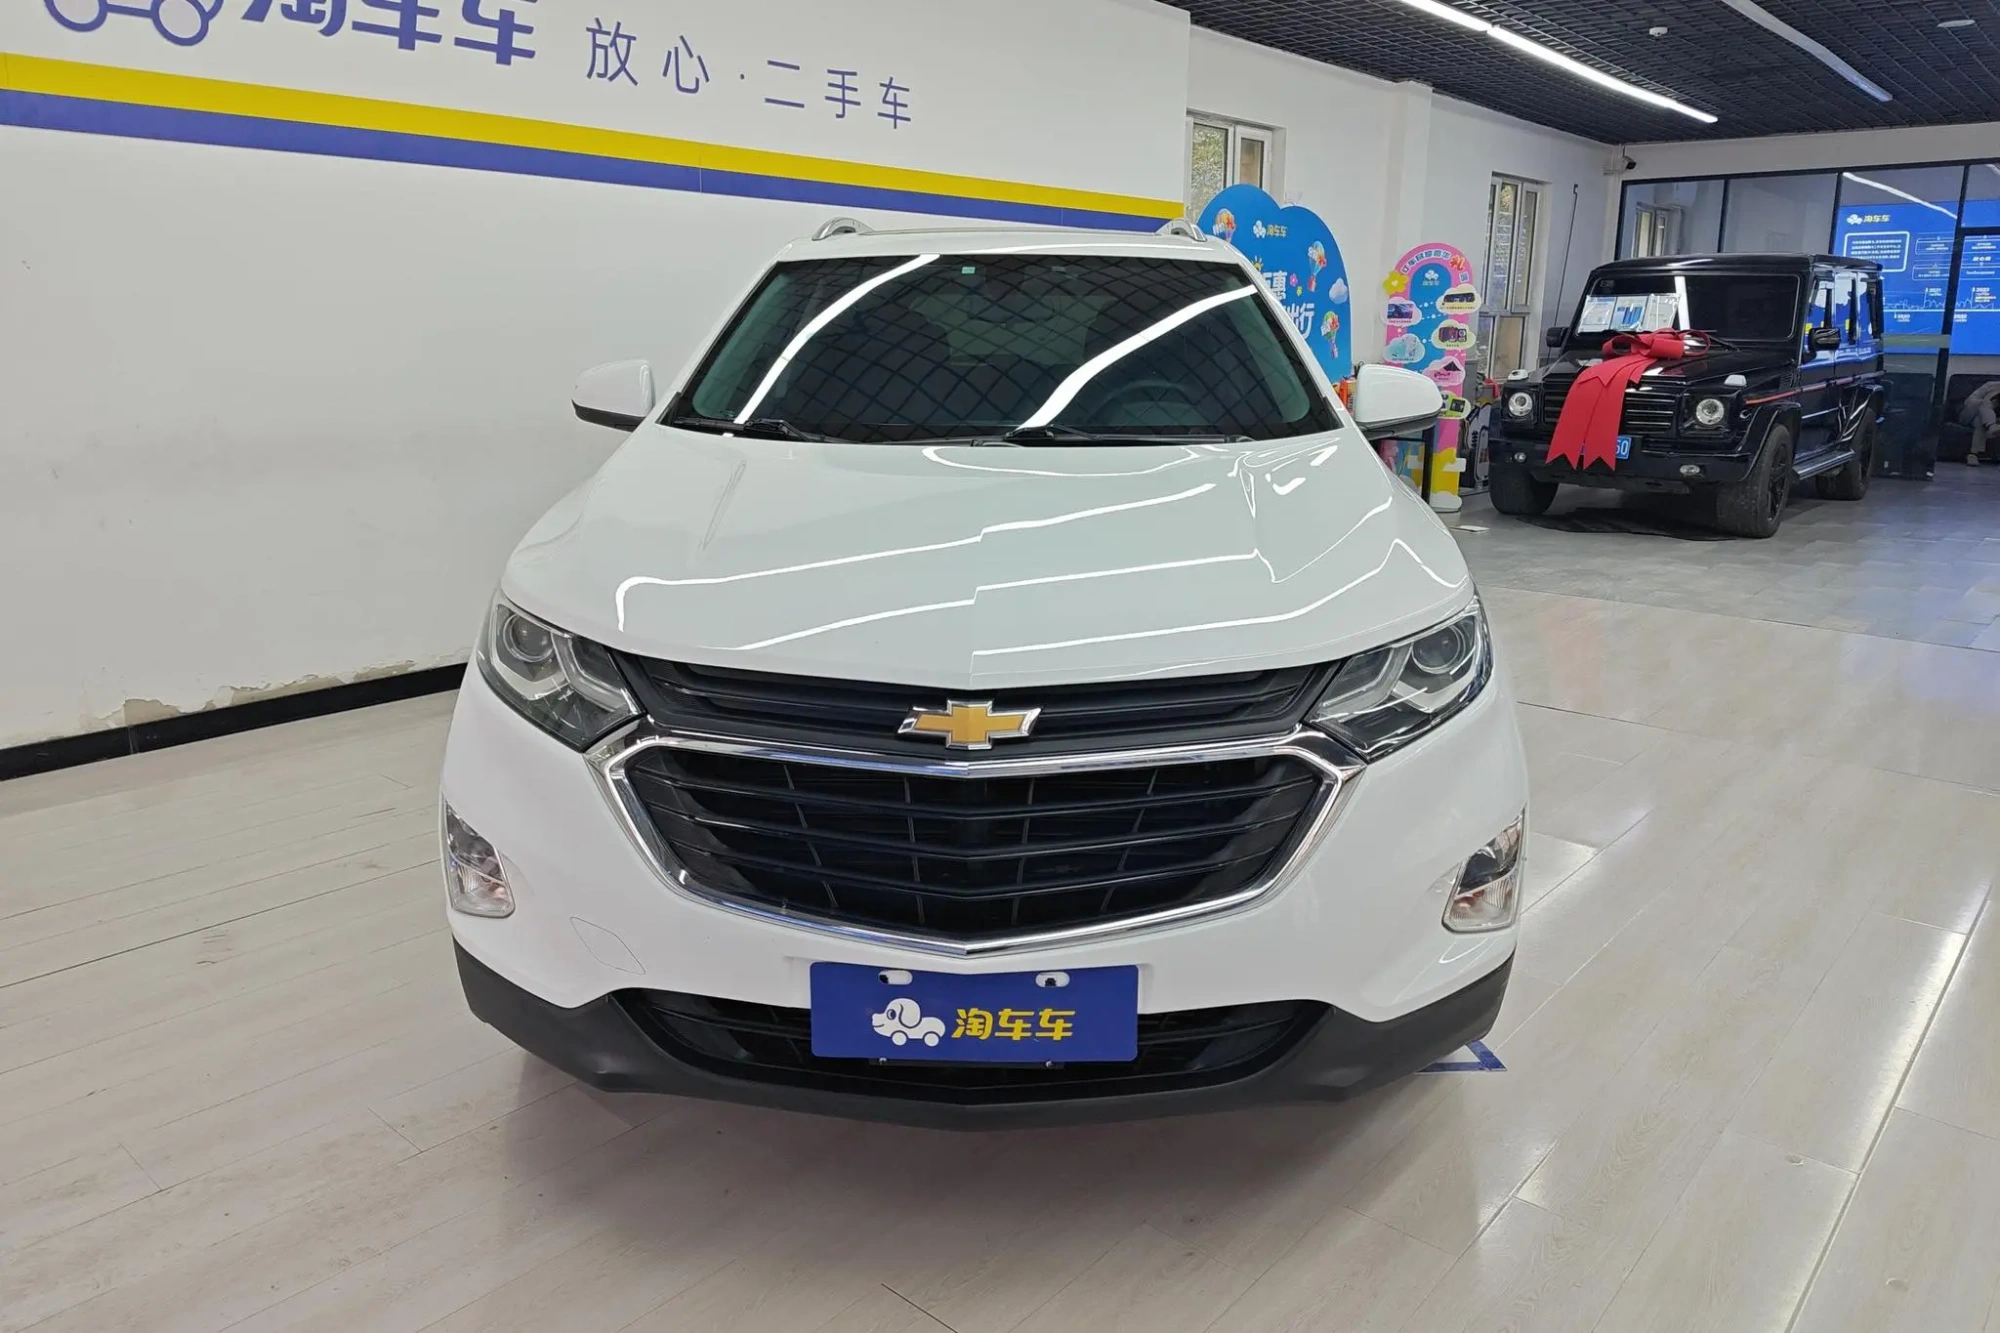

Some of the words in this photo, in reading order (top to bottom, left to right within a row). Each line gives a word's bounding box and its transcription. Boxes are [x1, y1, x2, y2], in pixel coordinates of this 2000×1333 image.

[586, 17, 912, 130] 放心·二手车
[952, 1007, 1076, 1041] 淘车车
